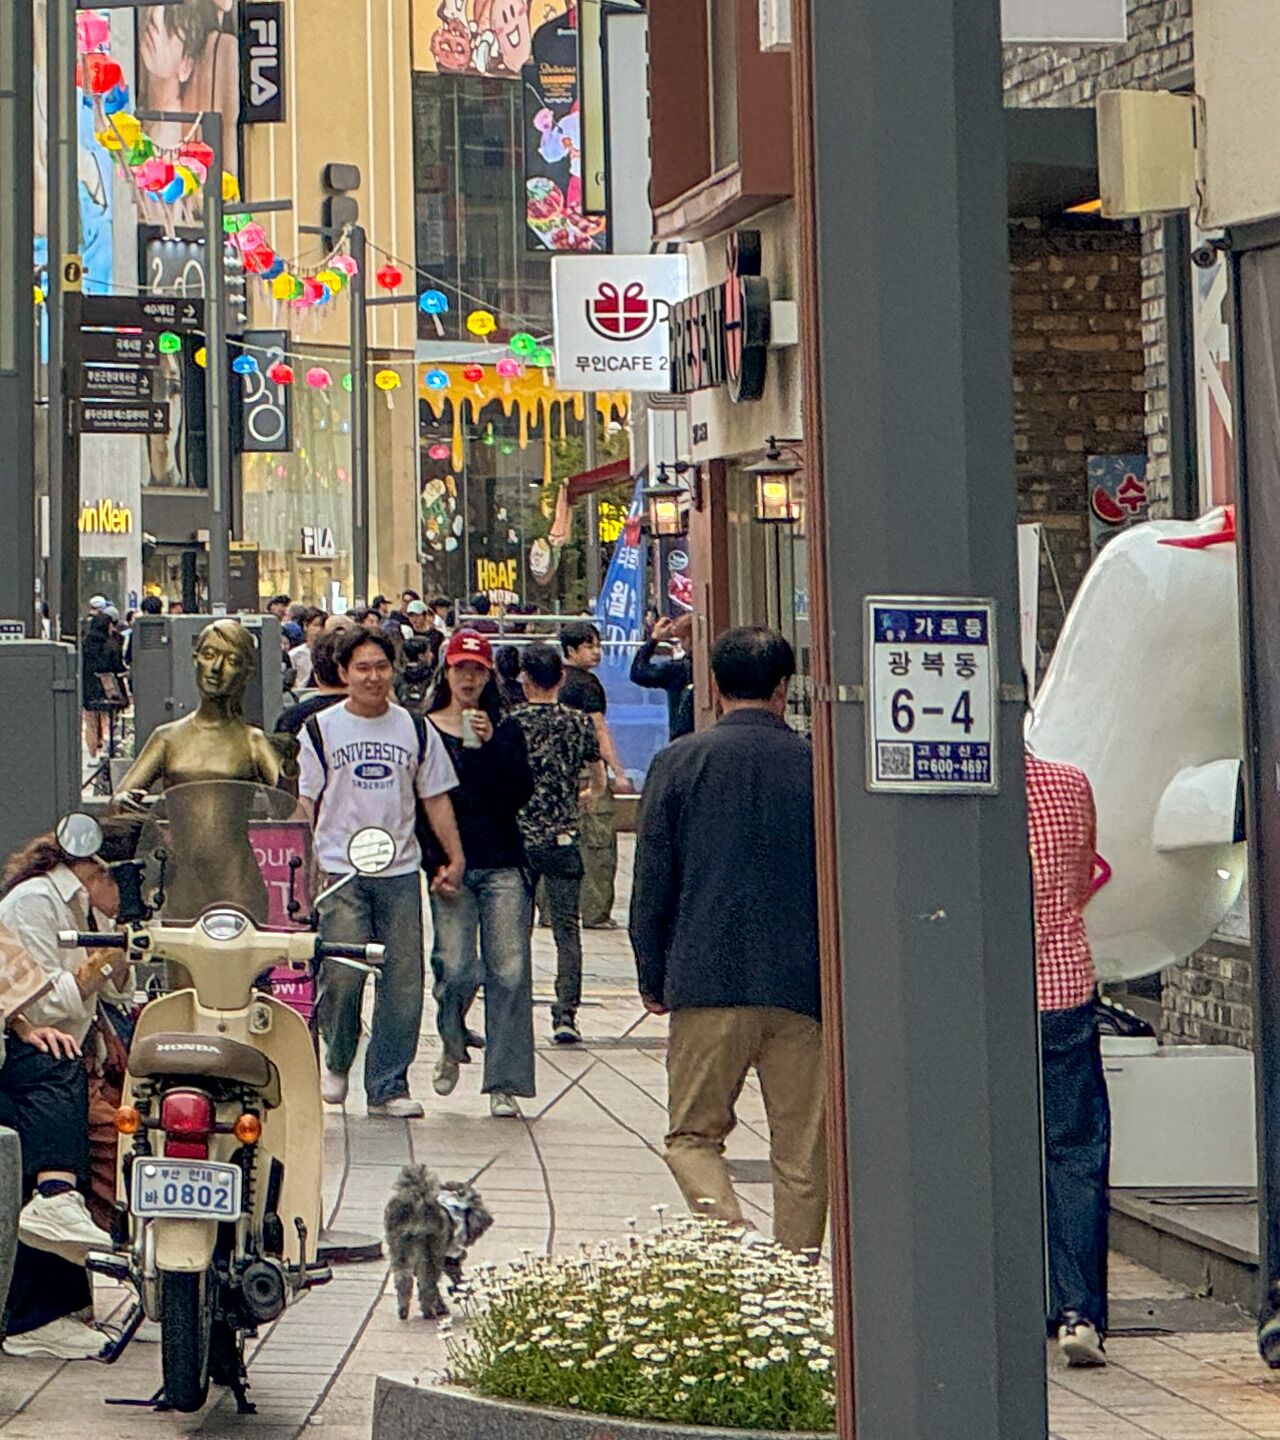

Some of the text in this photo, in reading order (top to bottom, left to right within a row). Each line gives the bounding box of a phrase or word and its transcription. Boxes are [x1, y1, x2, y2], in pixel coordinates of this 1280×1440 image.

[250, 19, 278, 106] FILA
[575, 356, 653, 372] 무인CAFE
[302, 526, 336, 556] FILA
[477, 558, 517, 592] HBAF
[891, 687, 976, 735] 6-4
[332, 741, 412, 770] UNIVERSITY
[156, 1042, 221, 1055] HONDA
[163, 1183, 228, 1210] 0802
